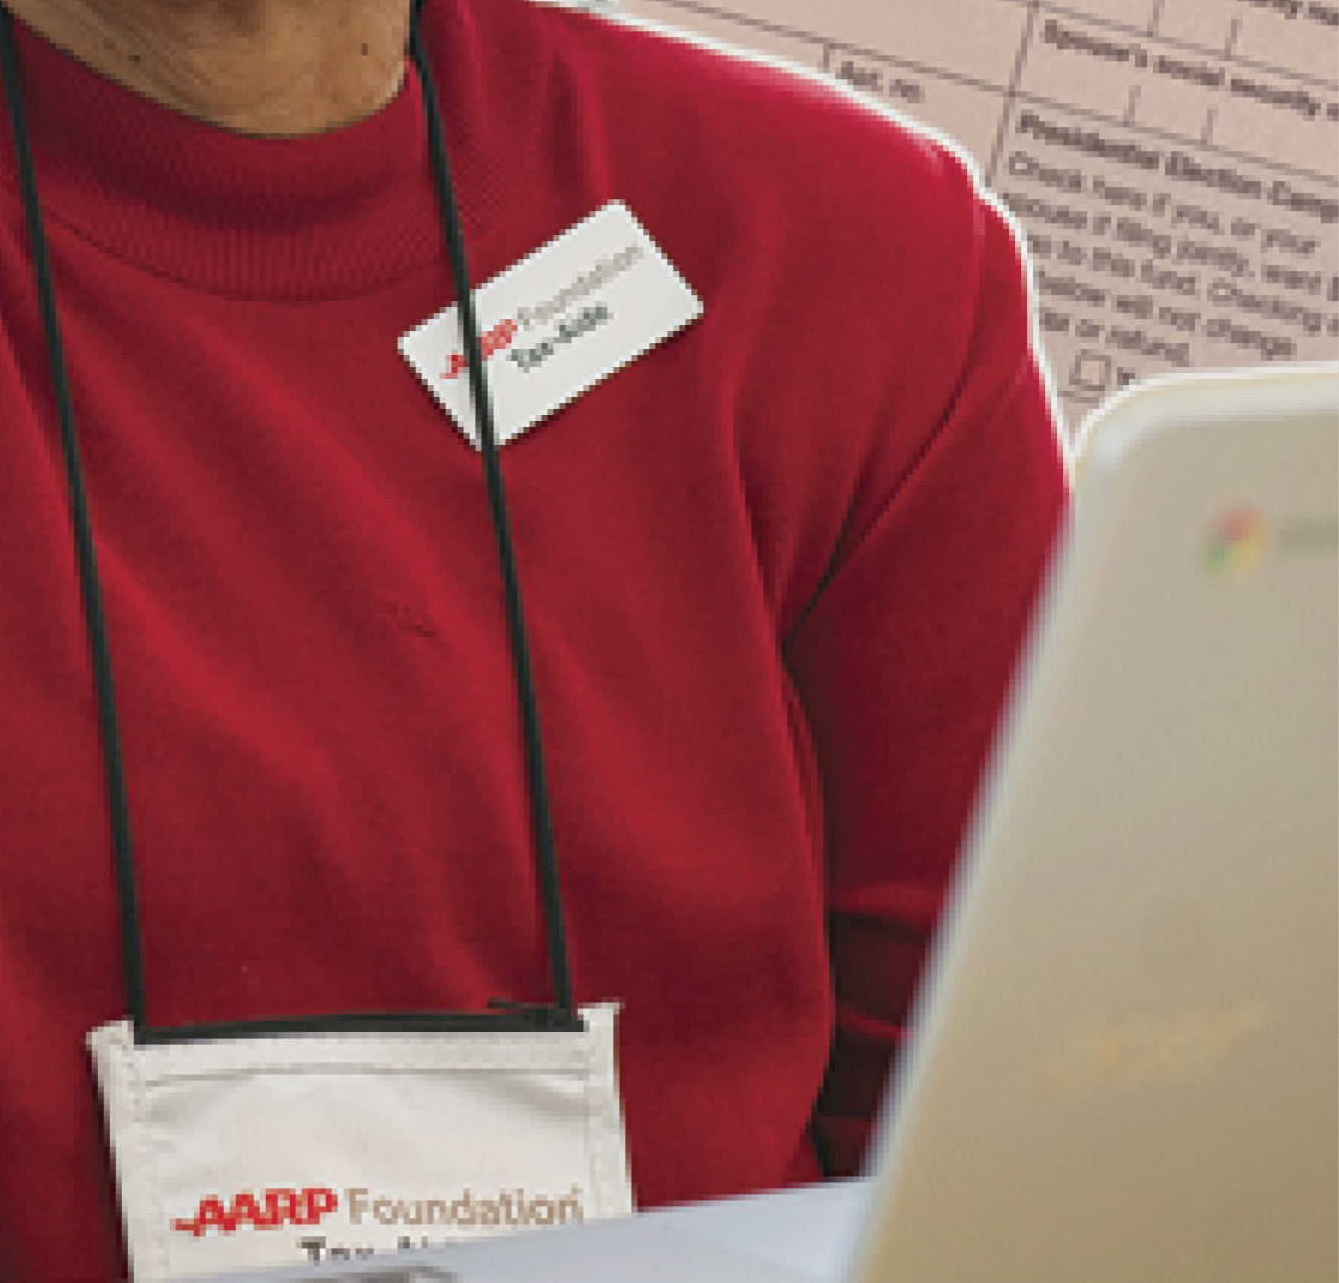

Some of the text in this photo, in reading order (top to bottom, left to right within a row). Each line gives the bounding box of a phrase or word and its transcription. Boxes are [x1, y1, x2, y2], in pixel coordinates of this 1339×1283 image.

[1153, 53, 1225, 90] social
[1229, 76, 1321, 121] security
[1016, 112, 1160, 169] Presidential
[1164, 150, 1264, 201] Election
[1007, 152, 1083, 194] Check
[1092, 175, 1148, 211] here
[1261, 228, 1318, 258] your
[1207, 278, 1323, 338] Checking
[1260, 263, 1323, 296] want
[173, 1186, 584, 1237] AARP Foundation
